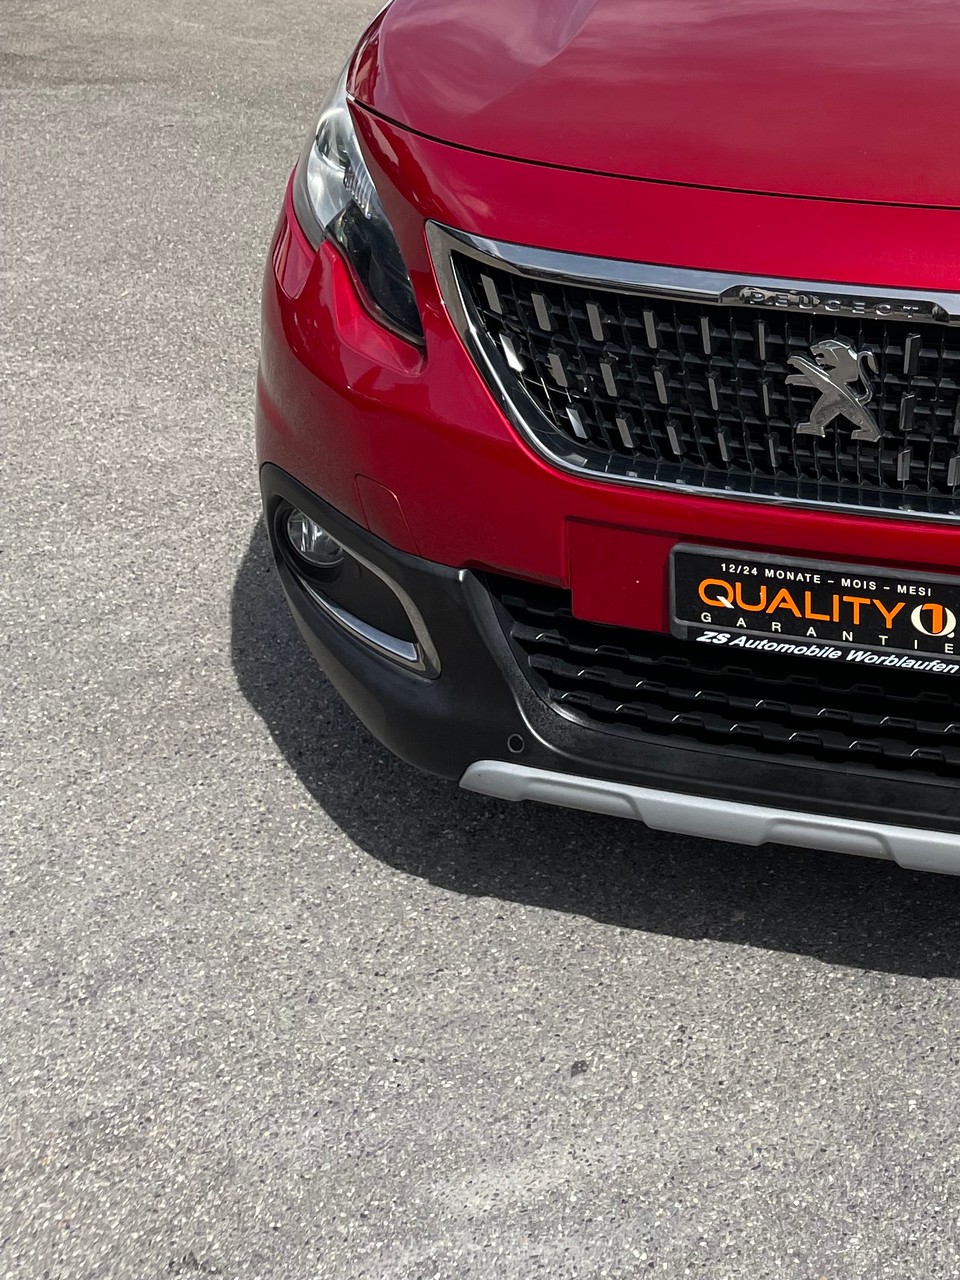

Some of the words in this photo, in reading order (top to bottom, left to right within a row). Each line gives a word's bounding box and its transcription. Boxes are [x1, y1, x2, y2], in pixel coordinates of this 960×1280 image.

[750, 291, 919, 318] PEUGEOT
[720, 563, 759, 577] 12/24
[765, 568, 821, 584] MONATE
[841, 578, 877, 591] MOIS
[897, 585, 932, 597] MESI
[698, 578, 906, 629] QUALITY
[696, 631, 731, 645] ZS
[729, 635, 843, 660] Automobile
[846, 650, 960, 674] Worblaufen
[700, 612, 955, 654] GARANTIE
